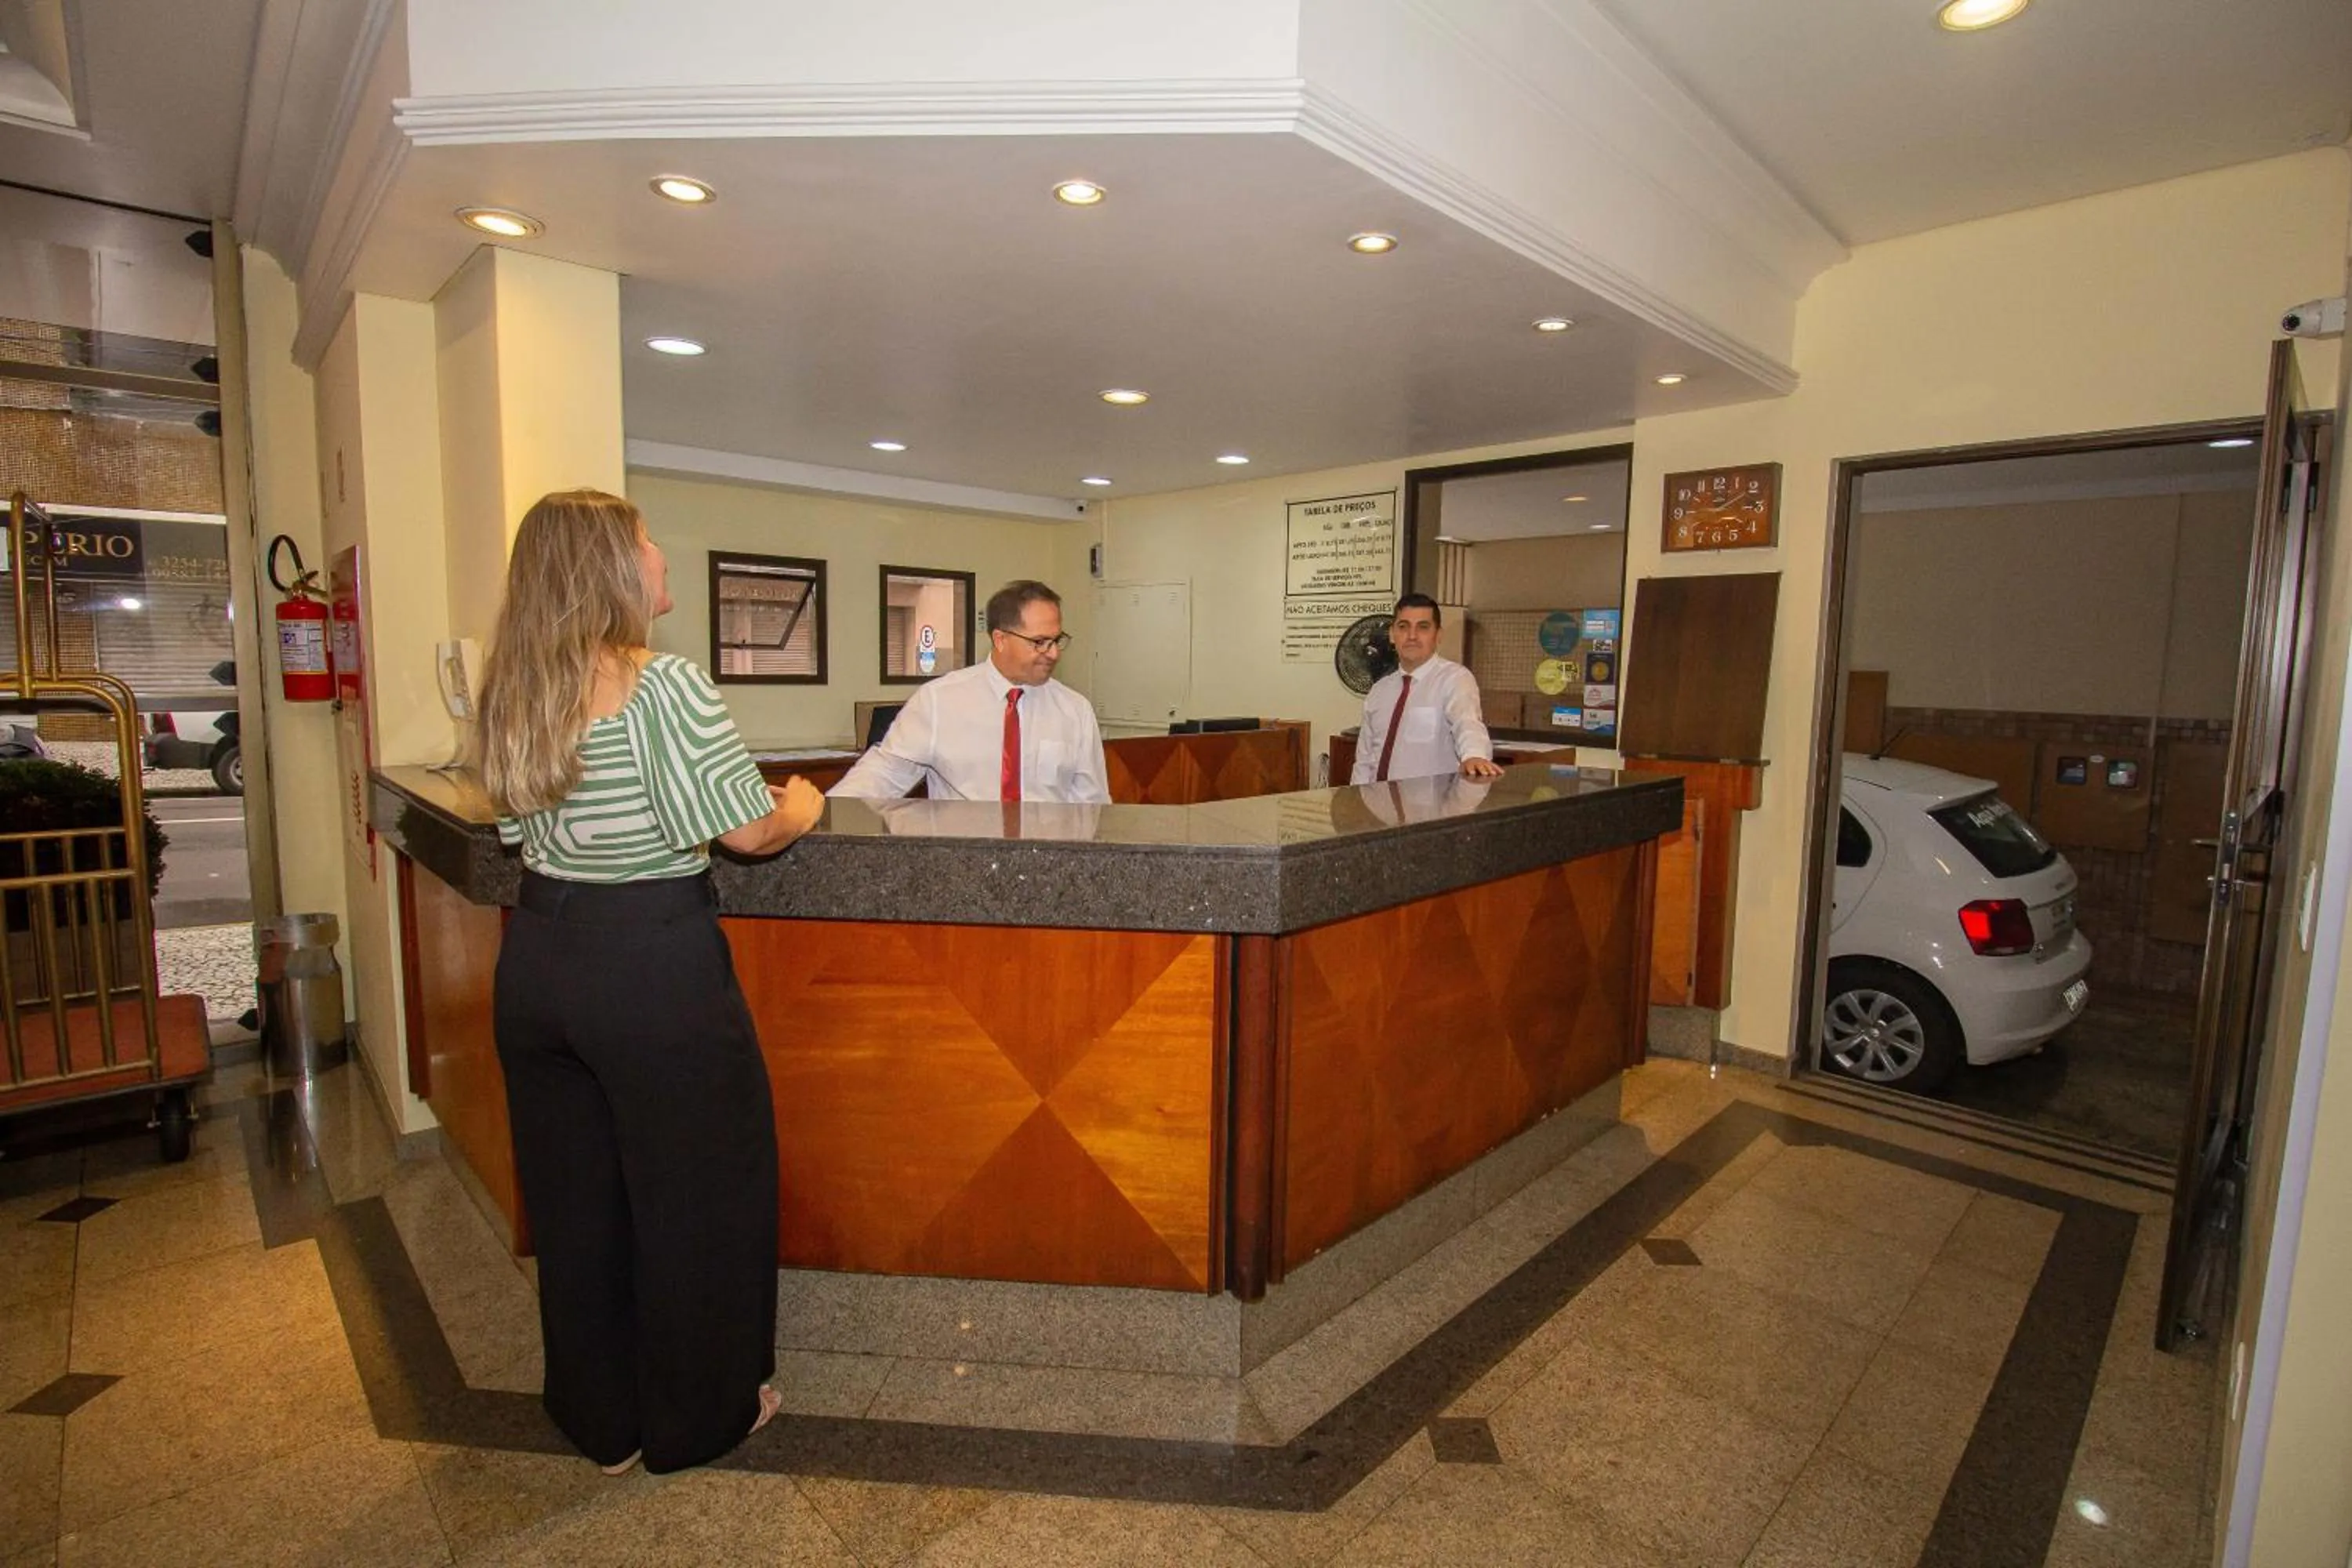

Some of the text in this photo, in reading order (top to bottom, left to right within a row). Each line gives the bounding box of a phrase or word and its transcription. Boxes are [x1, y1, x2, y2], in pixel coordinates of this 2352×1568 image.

[1697, 479, 1706, 493] 11
[1713, 477, 1726, 490] 12
[1734, 476, 1740, 490] 1
[1748, 481, 1759, 493] 2
[1678, 488, 1691, 501] 10
[1304, 501, 1376, 517] TABELA DE PREÇOS
[1674, 508, 1683, 520] 9
[1678, 526, 1687, 538] 8
[1746, 521, 1757, 533] 4
[1696, 531, 1704, 543] 7
[1711, 531, 1721, 543] 6
[1729, 529, 1738, 541] 5
[1351, 602, 1392, 613] CHEQUES
[924, 630, 931, 643] E
